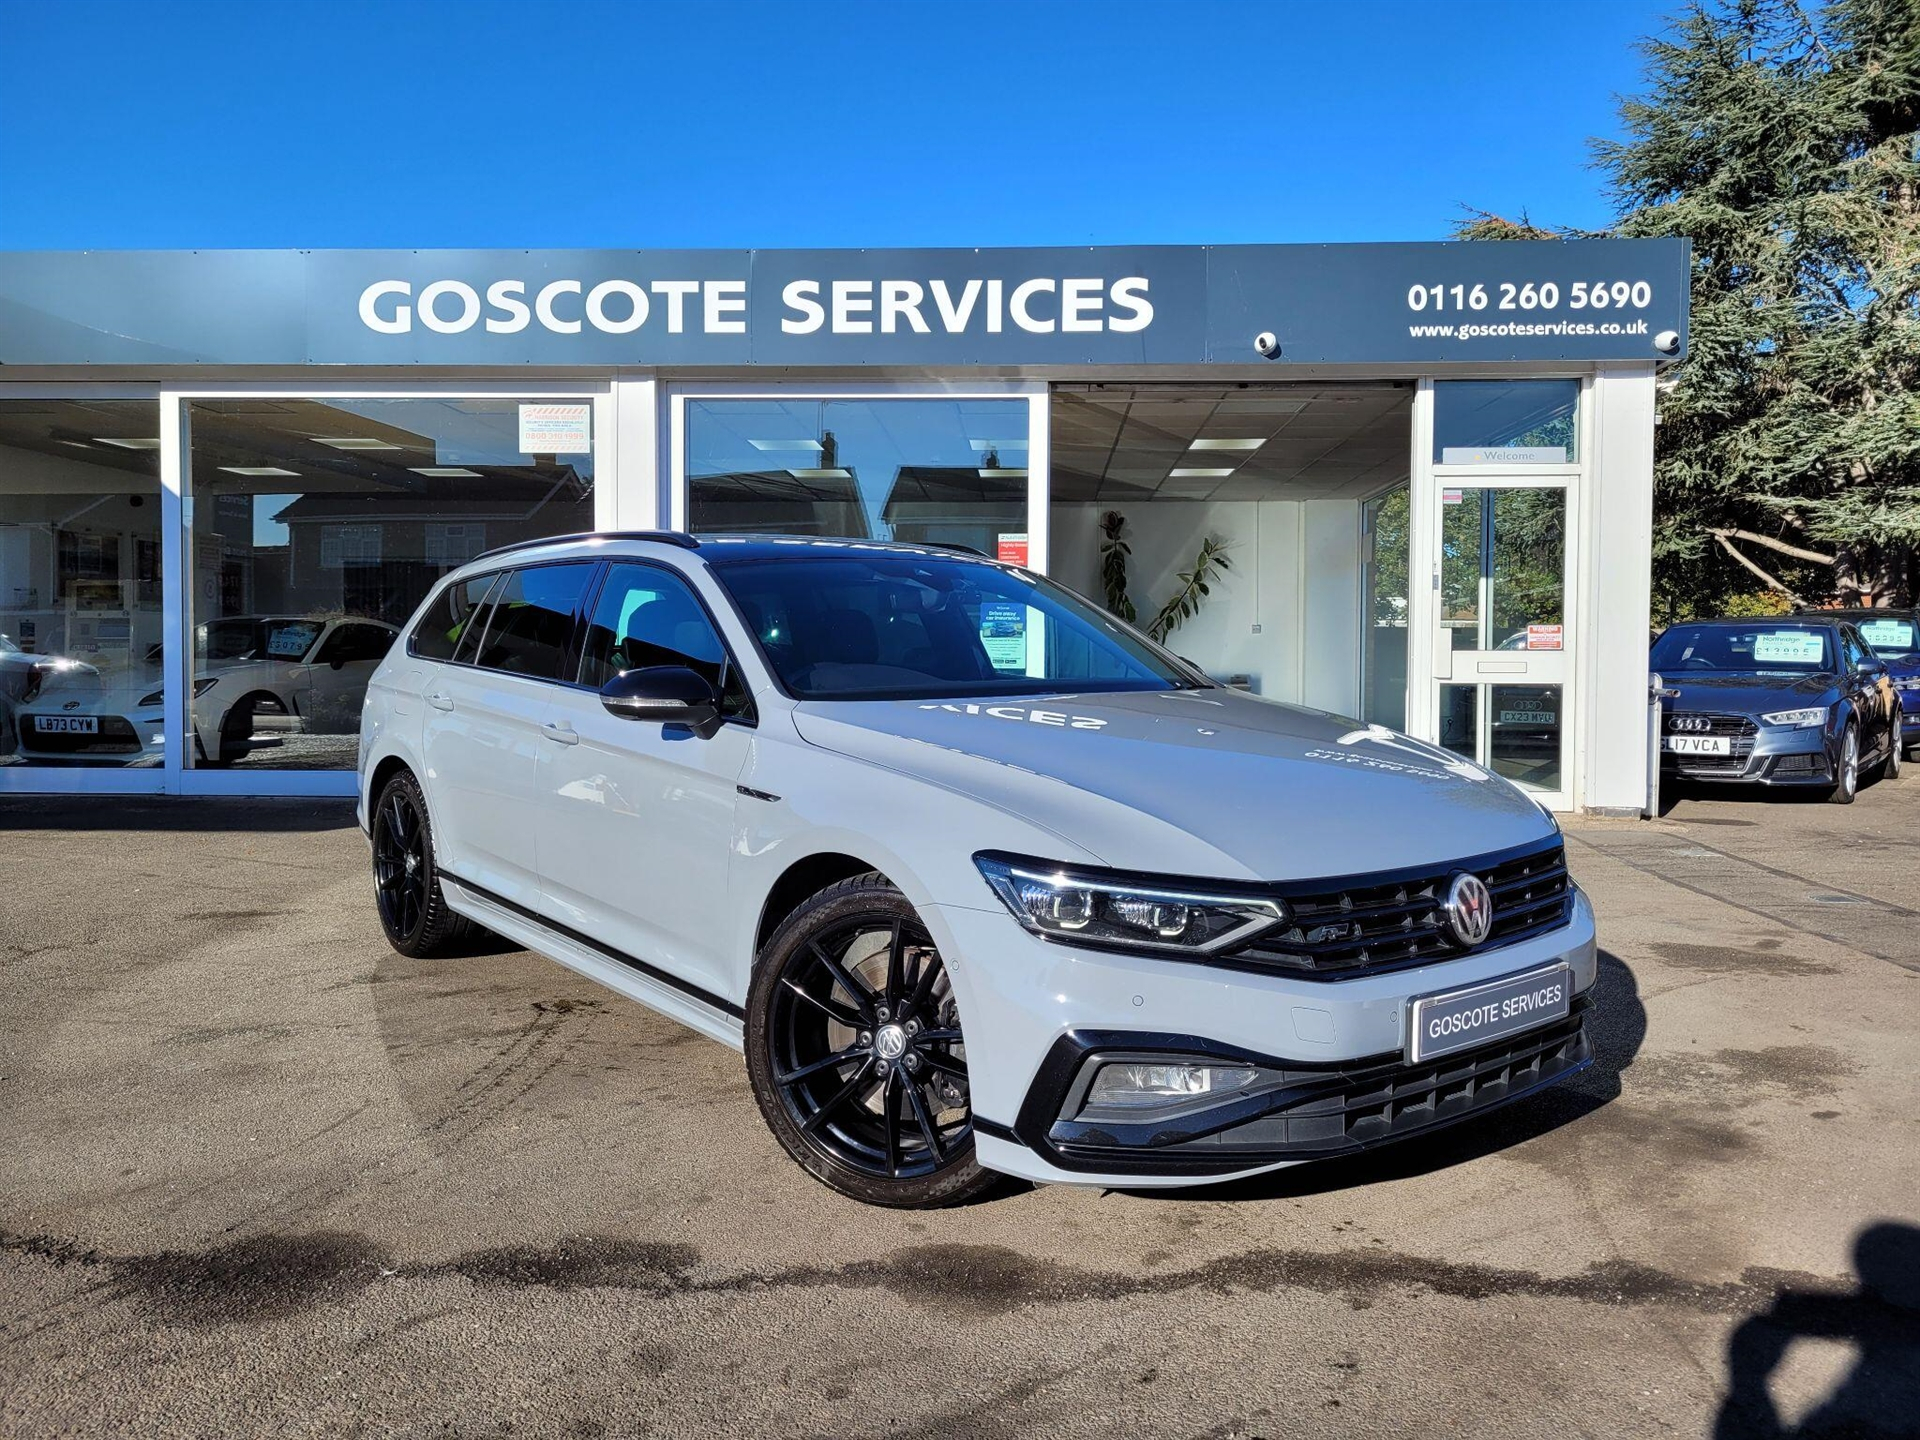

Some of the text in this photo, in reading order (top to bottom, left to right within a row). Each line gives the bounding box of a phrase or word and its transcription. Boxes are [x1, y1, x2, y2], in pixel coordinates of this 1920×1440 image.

[1407, 281, 1652, 311] 0116 260 5690
[358, 277, 1154, 335] GOSCOTE SERVICES
[1409, 319, 1648, 340] www.goscoteservices.co.uk
[525, 432, 547, 440] 0800
[1484, 451, 1535, 461] Welcome
[1504, 712, 1529, 722] CX23
[38, 718, 93, 731] LB73 CYW
[1692, 739, 1720, 752] VCA
[1429, 984, 1562, 1038] GOSCOTE SERVICES
